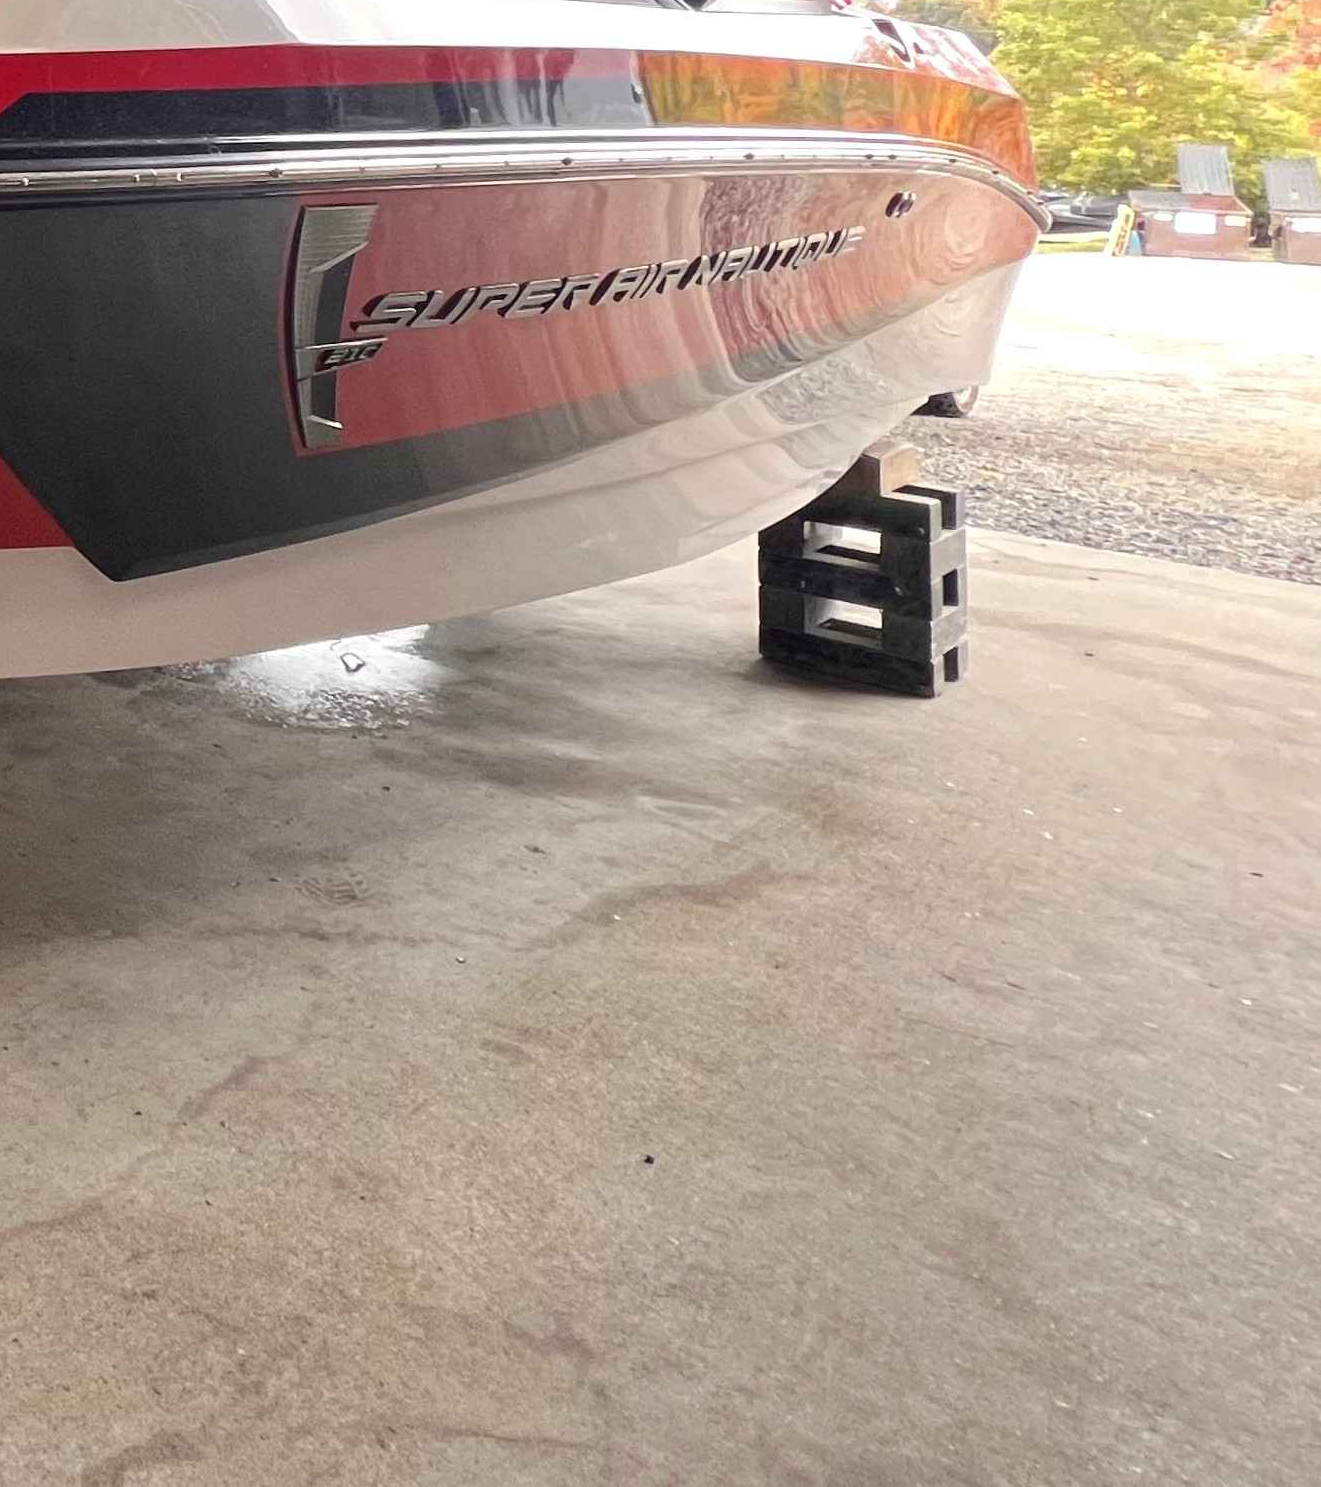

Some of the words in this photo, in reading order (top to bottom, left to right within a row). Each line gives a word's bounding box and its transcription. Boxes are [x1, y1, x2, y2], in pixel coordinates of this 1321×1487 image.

[354, 272, 601, 334] SUPER
[607, 258, 690, 301] AIR
[687, 224, 866, 288] NAUTIQUE
